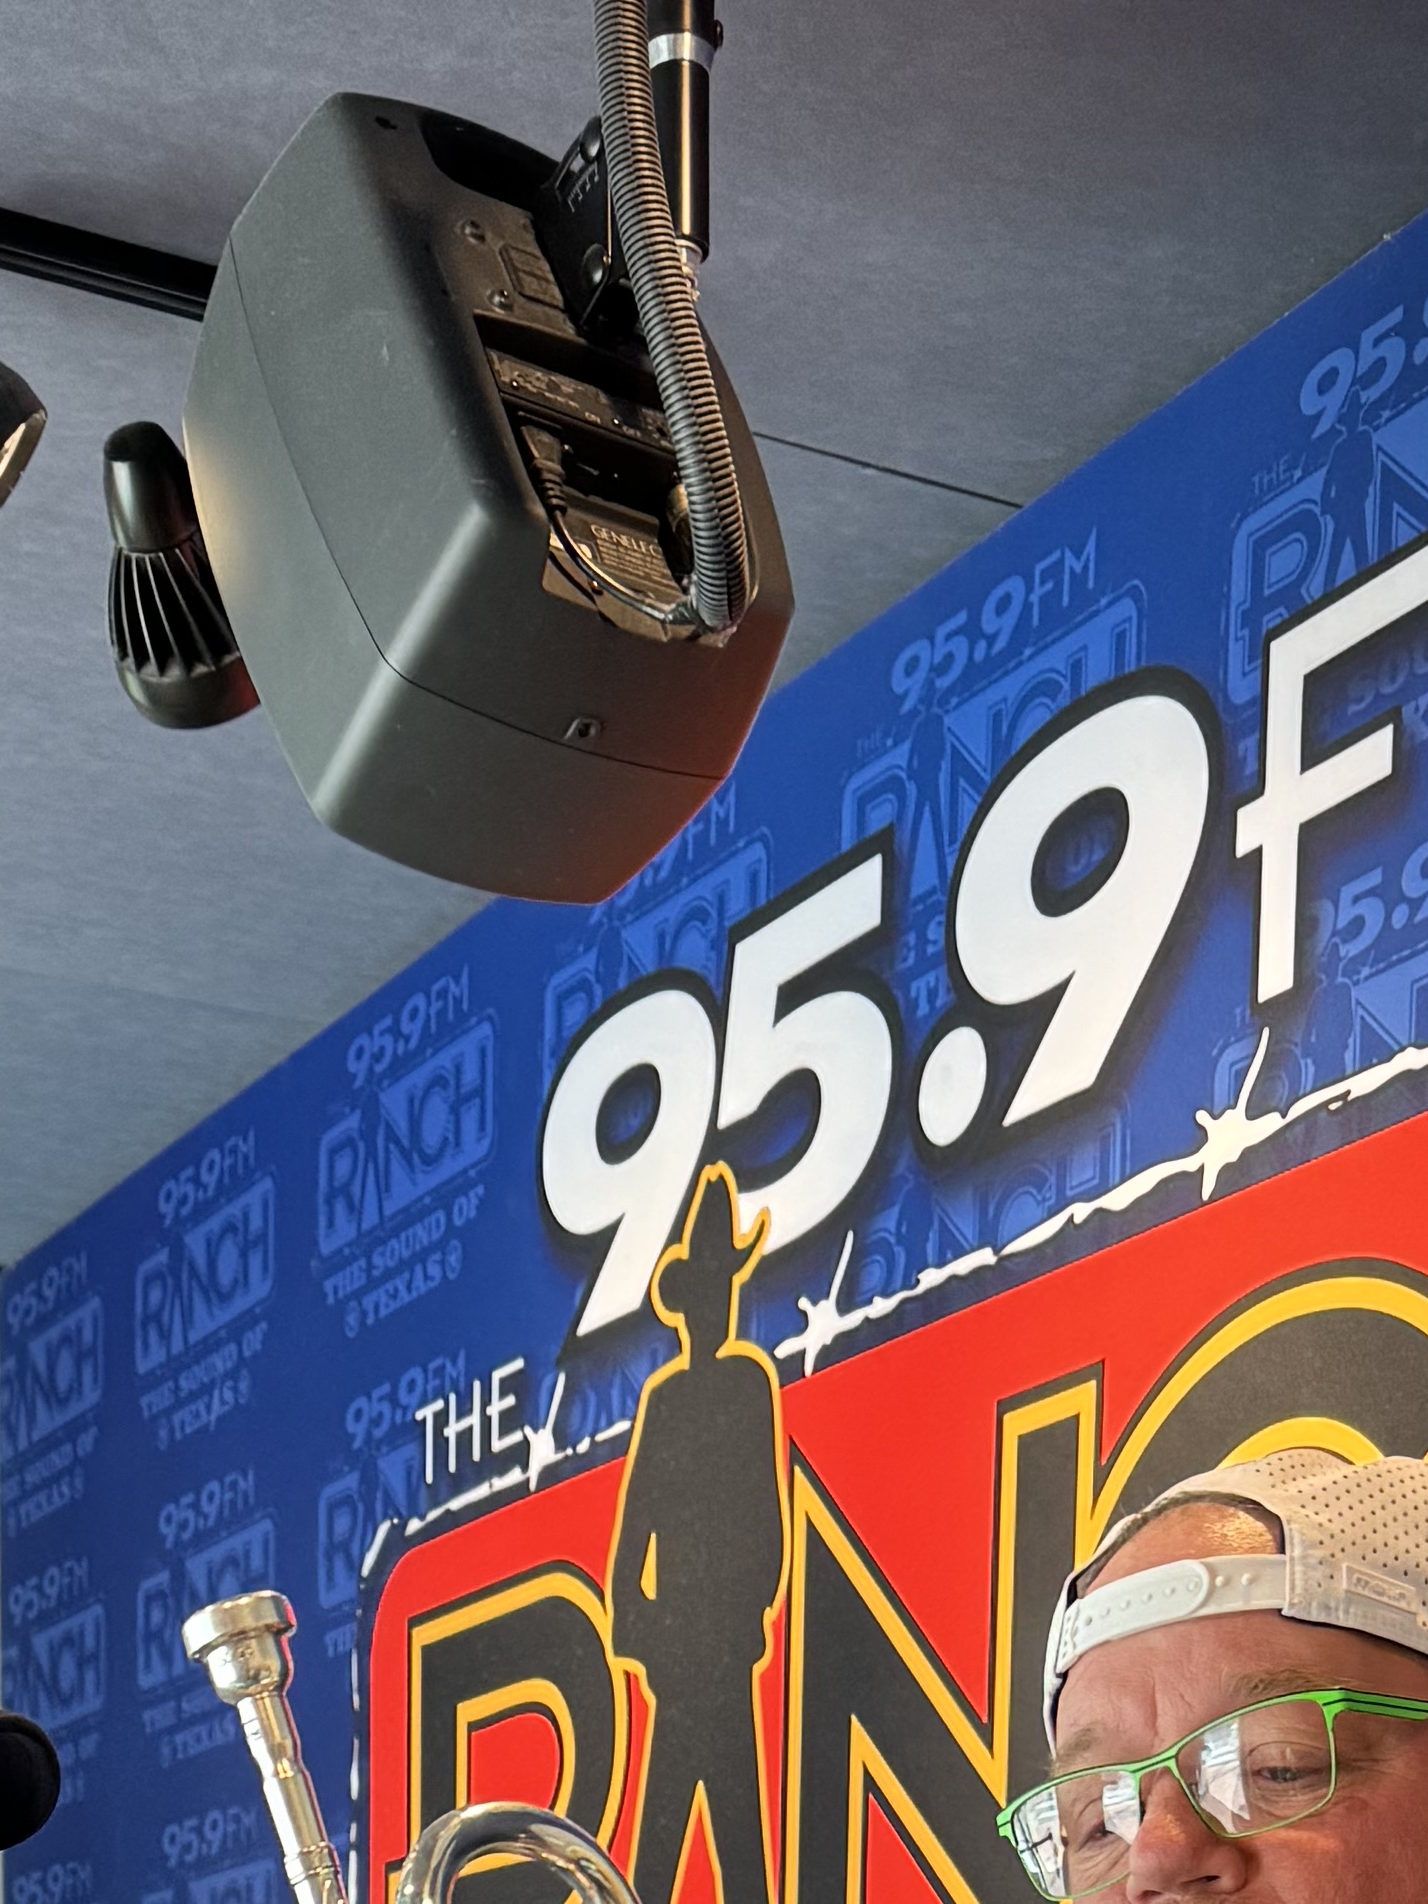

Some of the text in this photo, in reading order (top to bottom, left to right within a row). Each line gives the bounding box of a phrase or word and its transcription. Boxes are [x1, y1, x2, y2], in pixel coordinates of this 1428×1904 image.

[324, 1040, 489, 1243] RANCH
[323, 1183, 485, 1307] THE SOUND OF
[360, 1260, 445, 1328] TEXAS
[172, 1380, 235, 1438] TEXAS
[415, 1356, 525, 1485] THE
